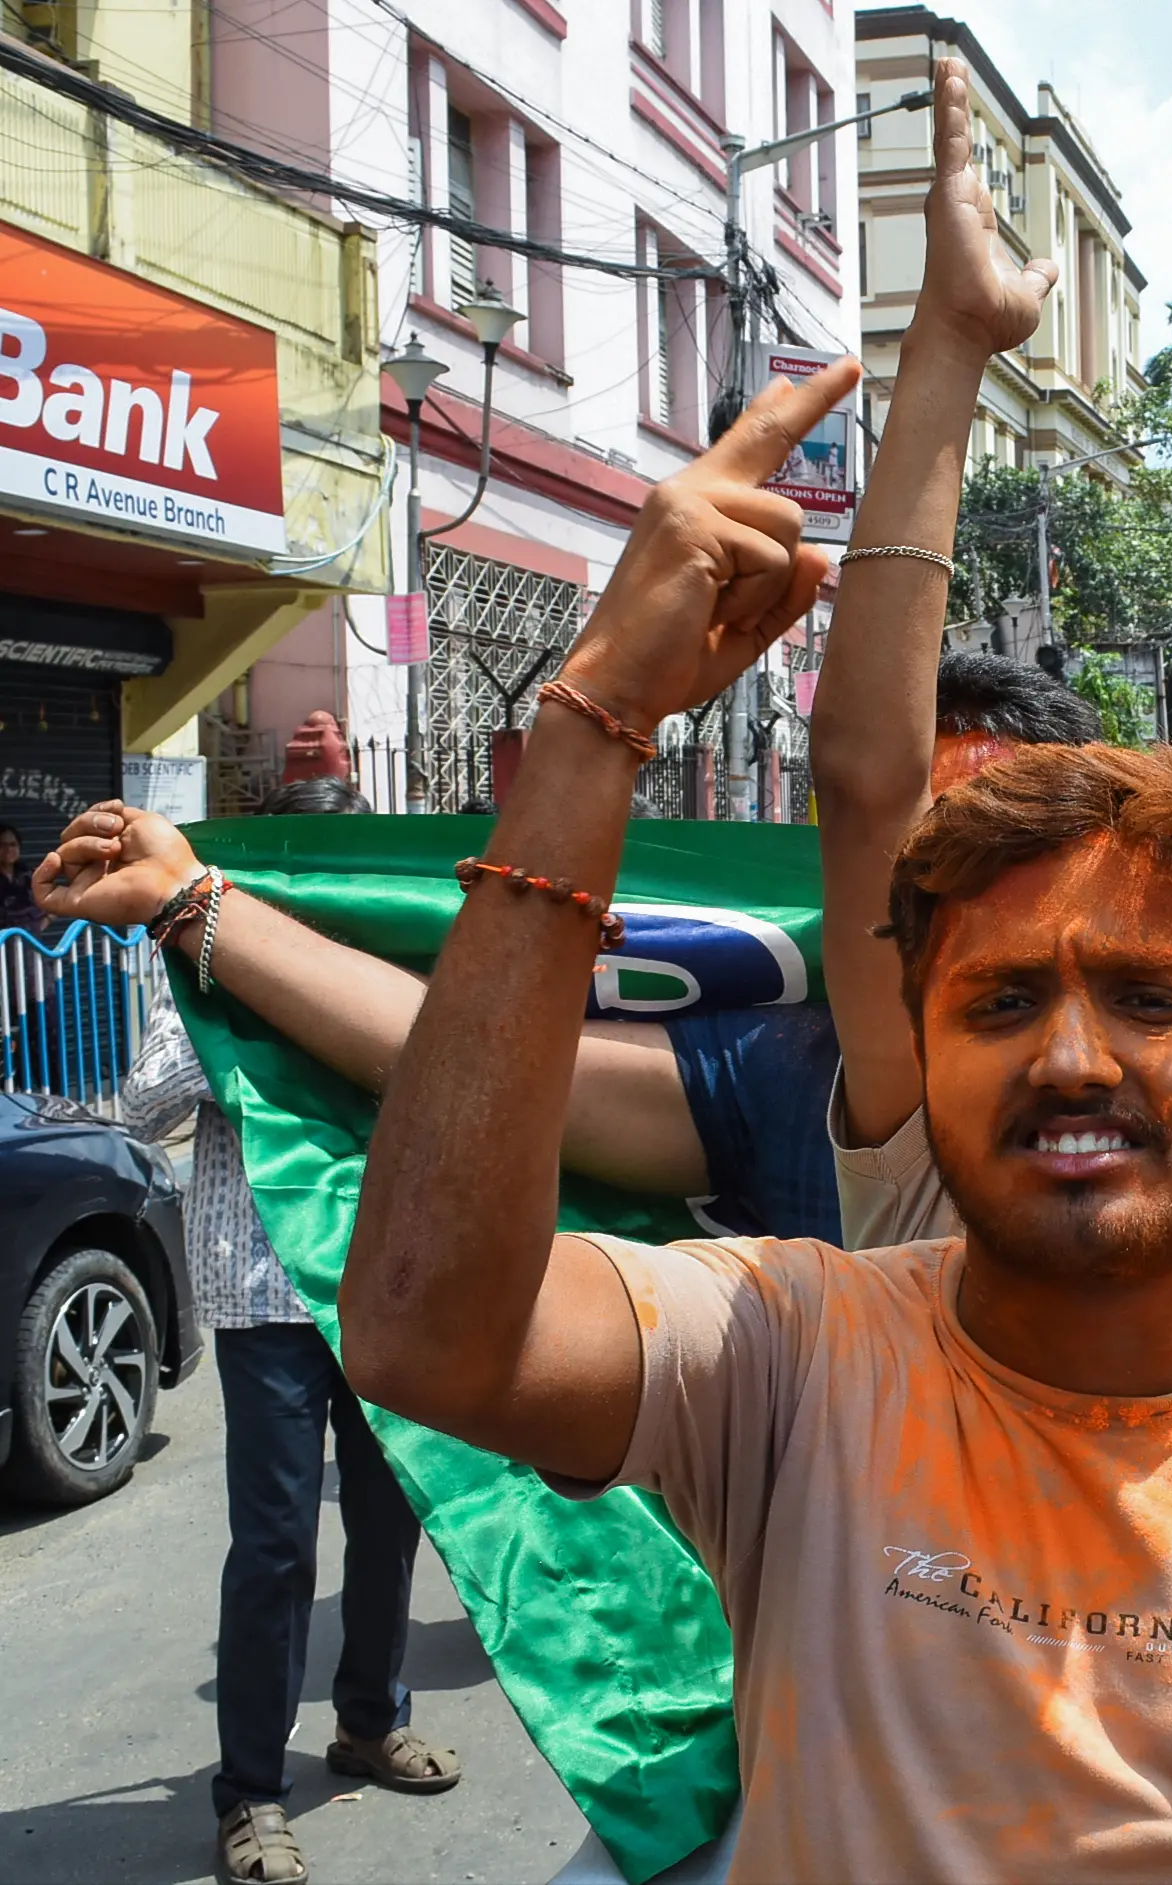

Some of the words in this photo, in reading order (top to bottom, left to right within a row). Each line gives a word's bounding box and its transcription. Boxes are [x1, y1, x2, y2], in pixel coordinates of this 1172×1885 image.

[0, 307, 220, 480] Bank
[44, 467, 58, 496] C
[65, 471, 79, 501] R
[86, 478, 158, 519] Avenue
[164, 496, 225, 534] Branch
[121, 762, 140, 776] DEB
[142, 762, 194, 776] SCIENTIFIC
[883, 1546, 971, 1582] The
[884, 1577, 971, 1618] American
[1126, 1651, 1163, 1664] FAST
